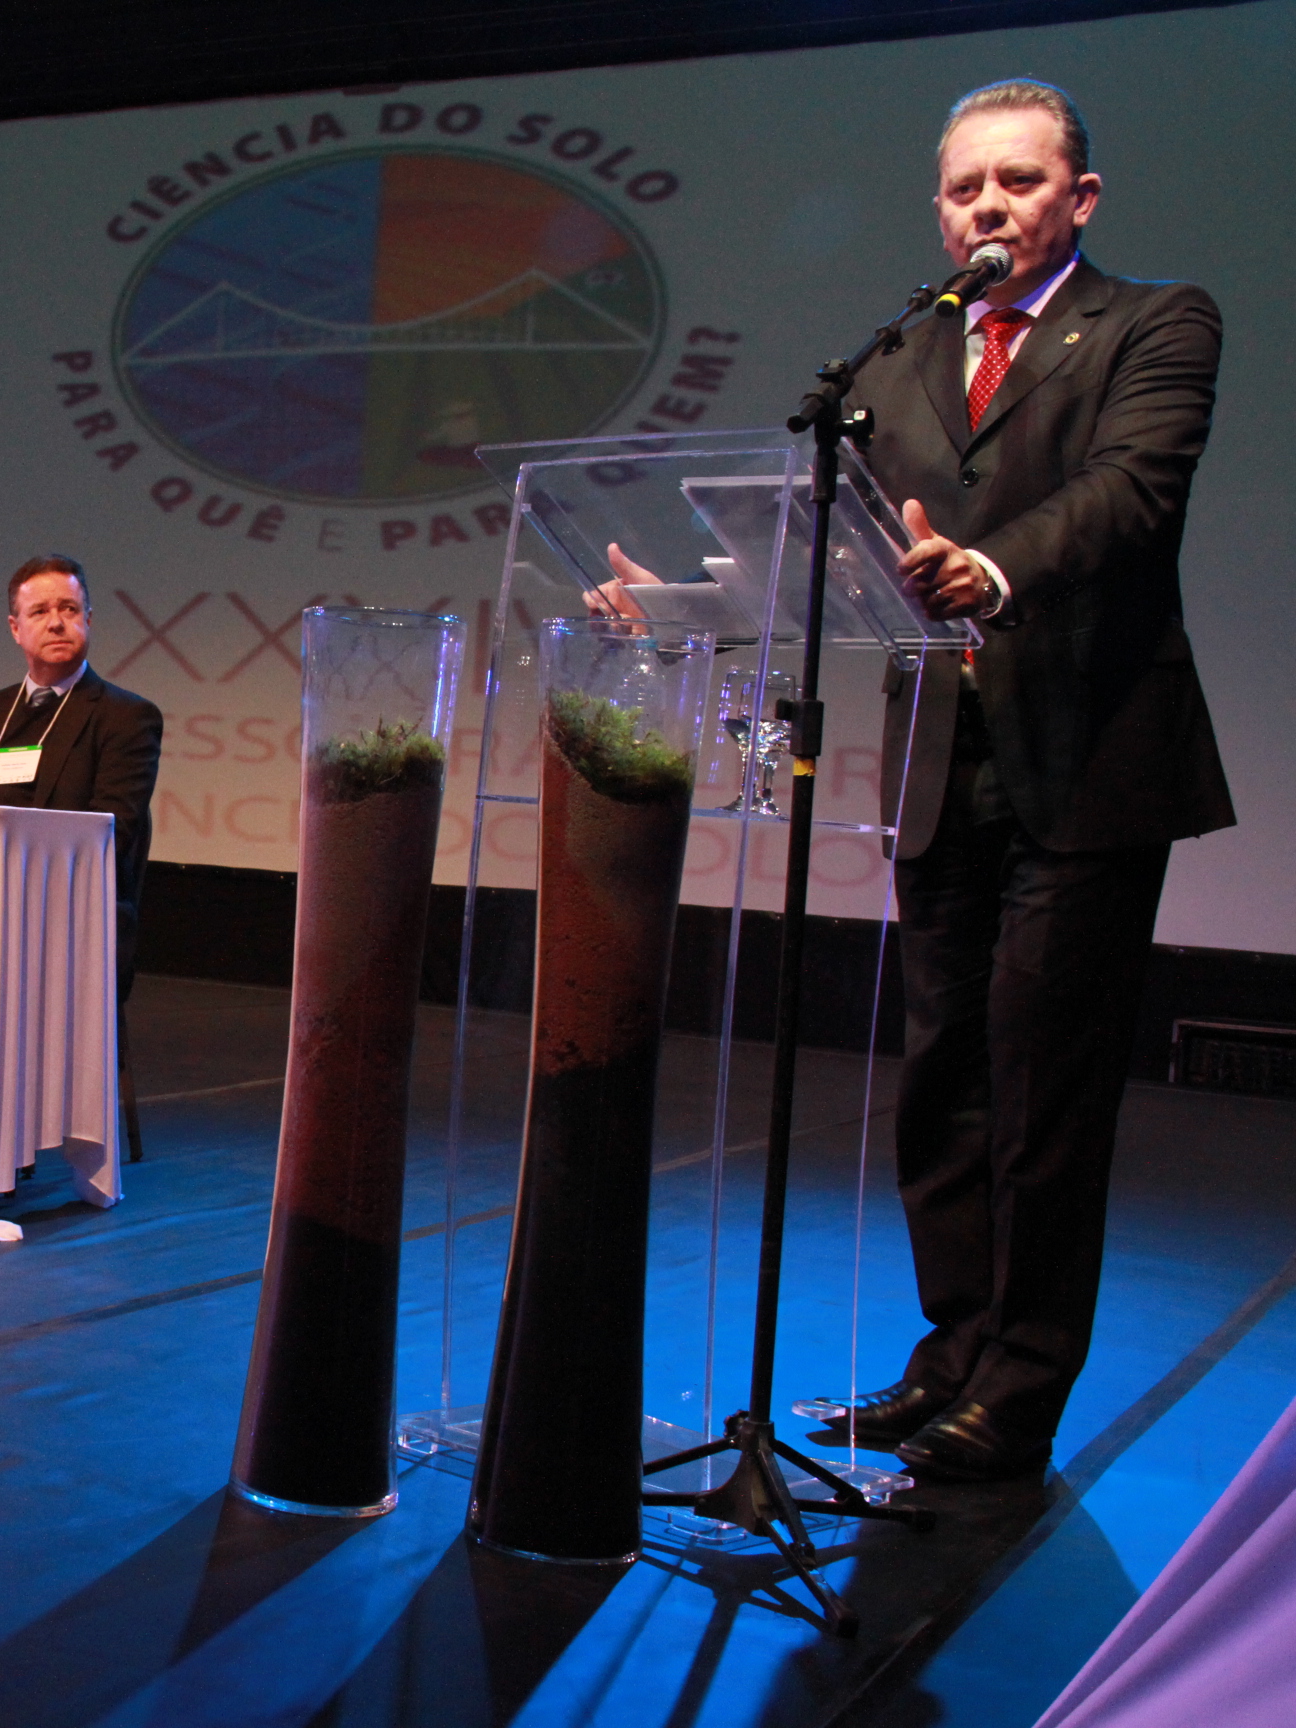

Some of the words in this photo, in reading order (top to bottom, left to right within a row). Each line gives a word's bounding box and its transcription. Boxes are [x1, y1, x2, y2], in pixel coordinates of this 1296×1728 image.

[105, 111, 348, 244] CIÊNCIA
[377, 101, 485, 136] DO
[504, 111, 681, 204] SOLO
[51, 348, 141, 472] PARA
[149, 475, 287, 544] QUÊ
[317, 517, 346, 553] E
